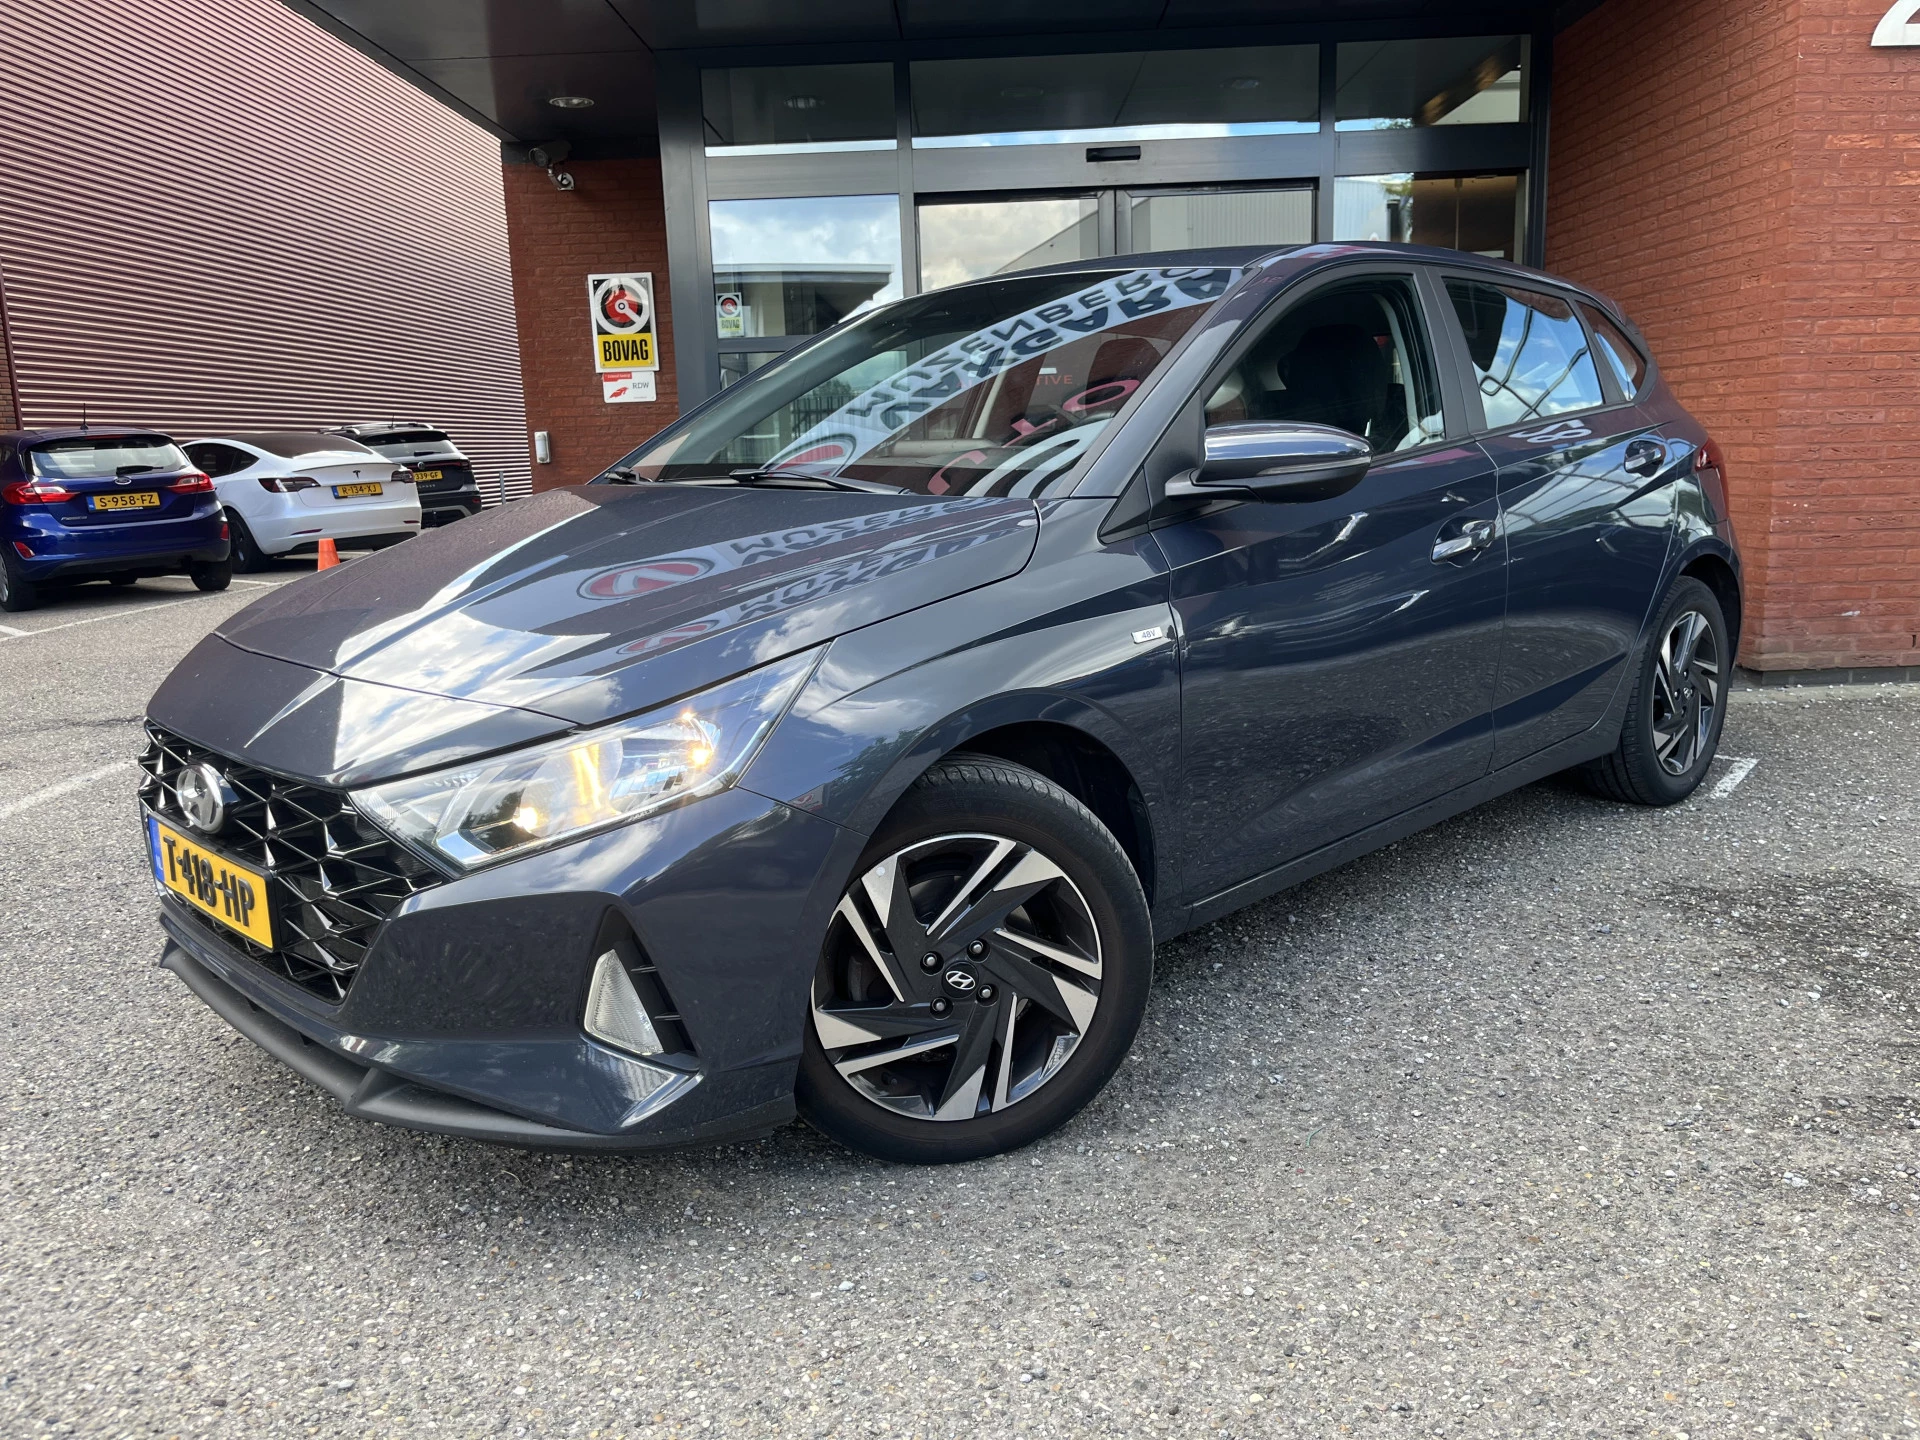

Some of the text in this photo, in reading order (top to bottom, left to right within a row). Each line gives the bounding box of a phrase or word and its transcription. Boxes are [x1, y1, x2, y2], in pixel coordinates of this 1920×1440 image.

[721, 319, 740, 329] BOVAG
[603, 339, 649, 362] BOVAG
[341, 484, 377, 494] R-134-XJ
[99, 494, 156, 508] S-958-FZ
[1141, 629, 1156, 639] 48V
[163, 835, 255, 928] T-418-HP
